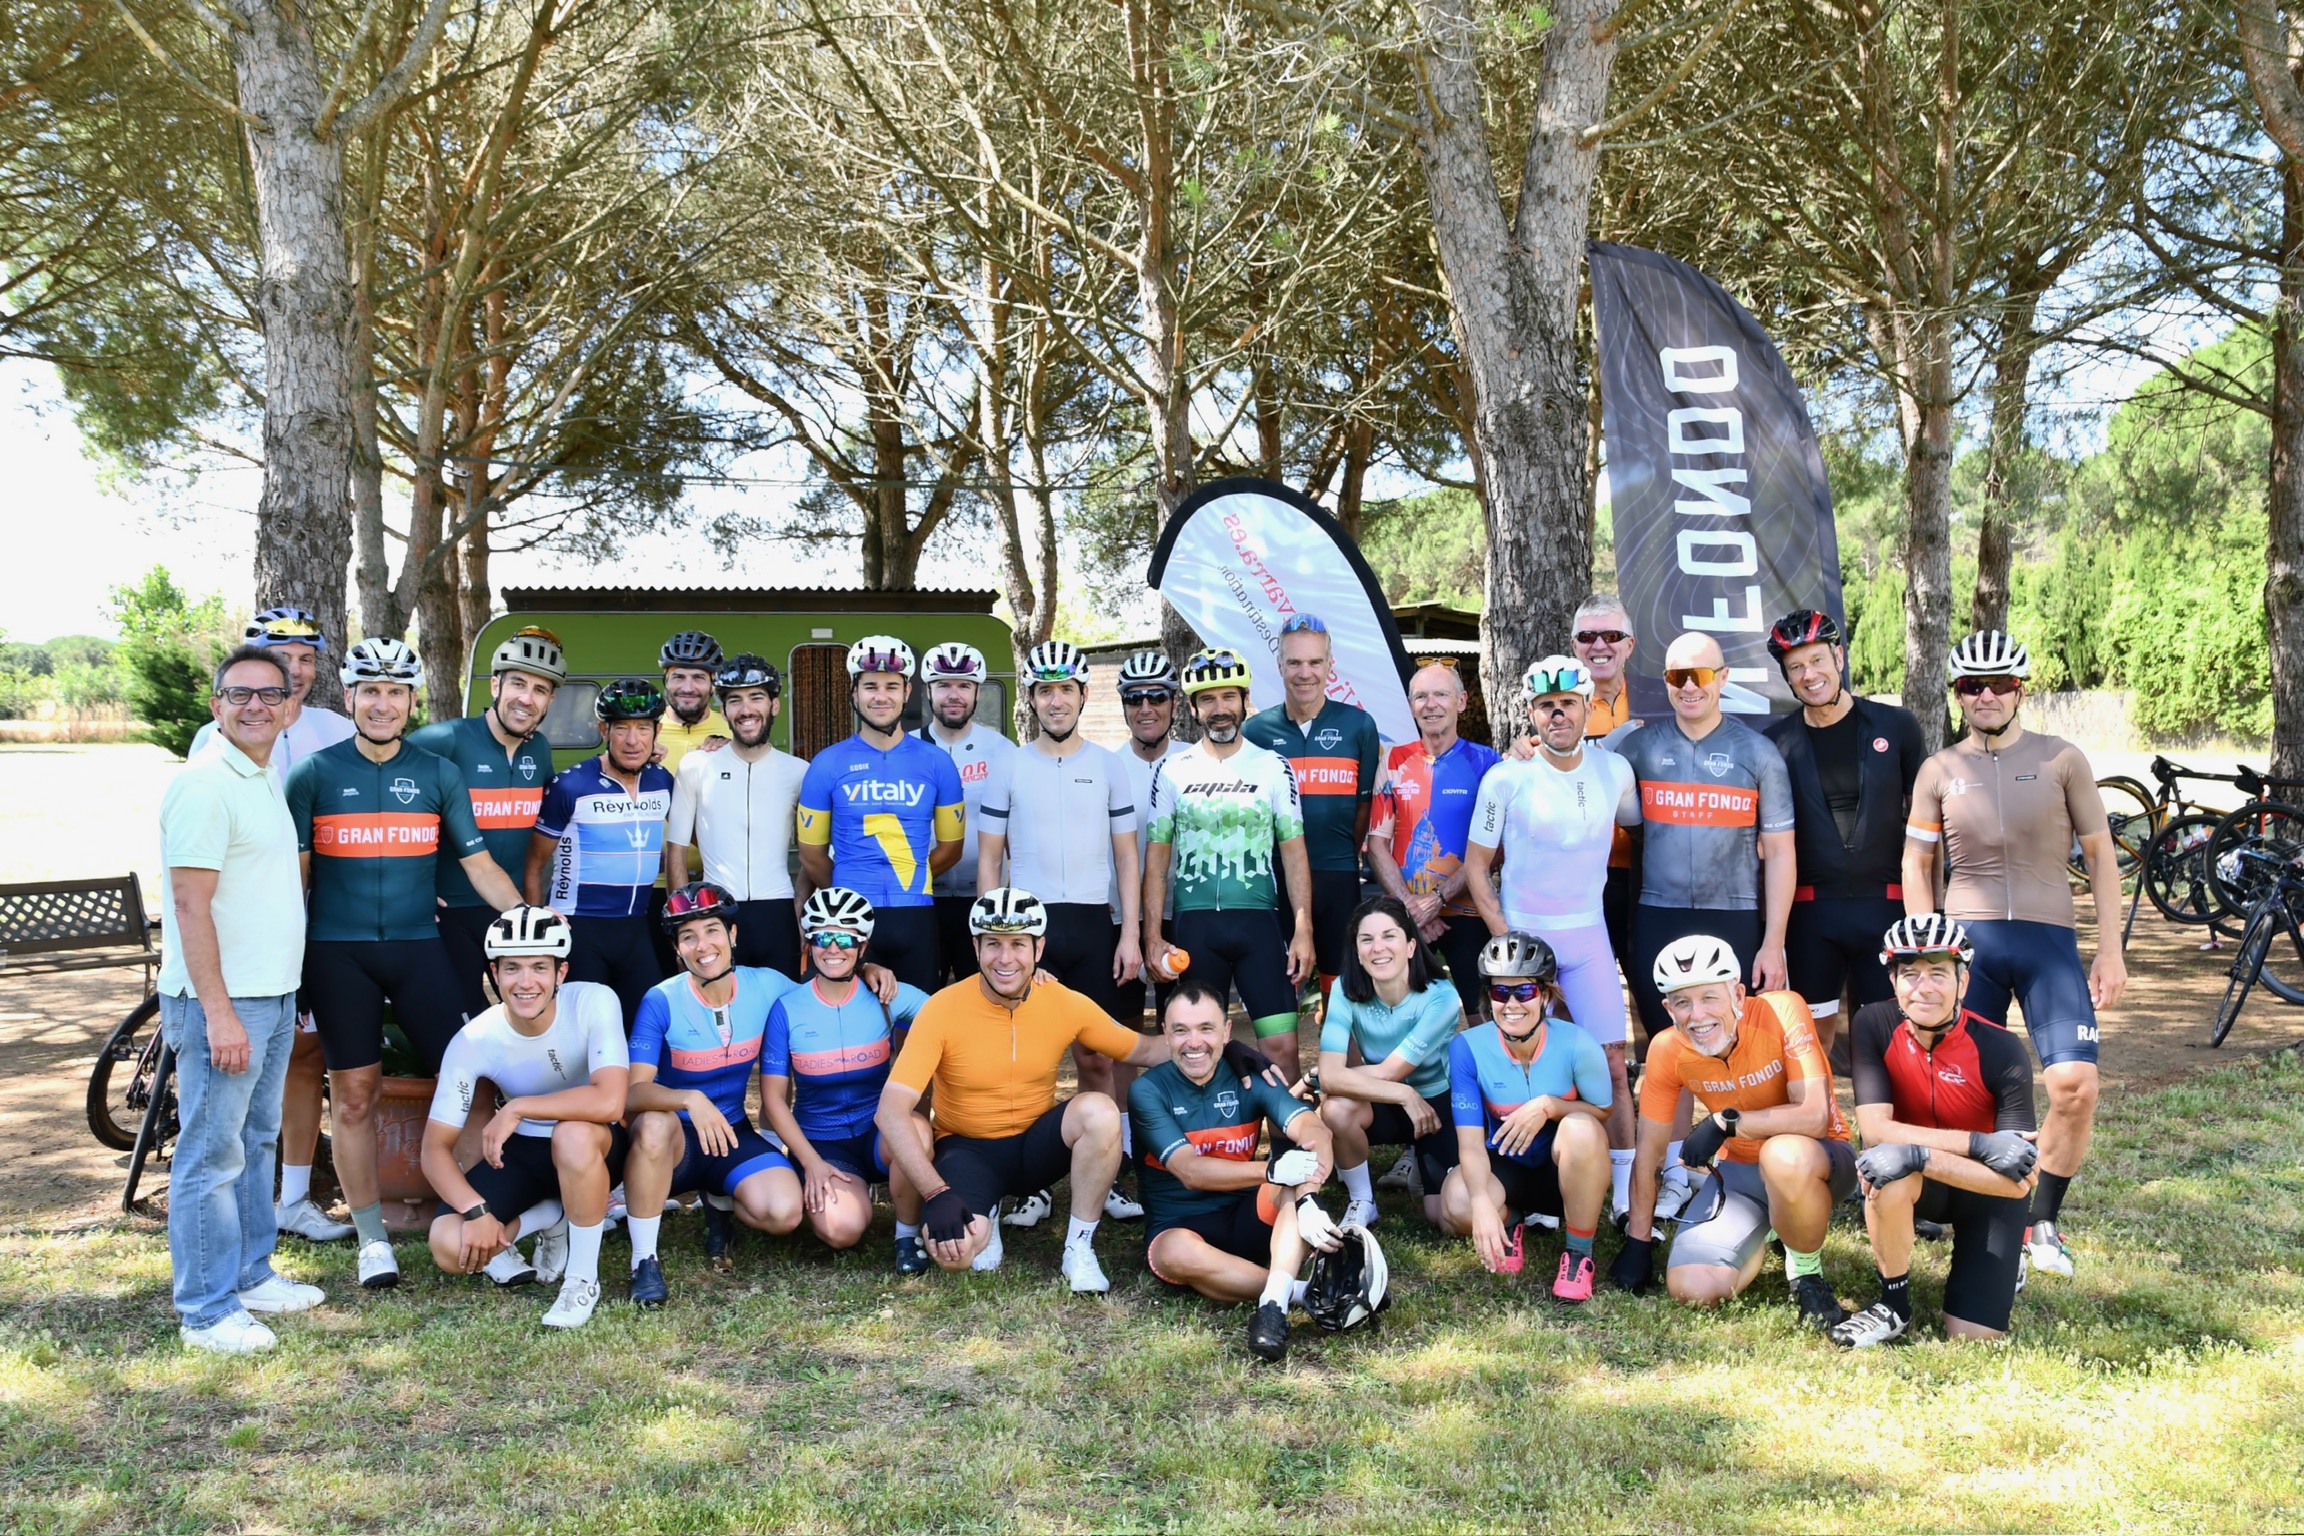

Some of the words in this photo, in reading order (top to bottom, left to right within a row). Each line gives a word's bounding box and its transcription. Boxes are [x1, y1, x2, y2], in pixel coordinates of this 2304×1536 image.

[1310, 768, 1354, 784] FONDO
[842, 779, 926, 807] vitaly
[1576, 781, 1585, 808] tactic
[1655, 789, 1695, 808] GRAN
[1698, 792, 1752, 811] FONDO
[472, 801, 512, 817] GRAN
[1483, 800, 1496, 833] tactic
[1673, 810, 1713, 819] STAFF
[338, 827, 383, 844] GRAN
[388, 826, 436, 843] FONDO
[547, 1048, 562, 1072] tactic
[682, 1055, 719, 1067] LADIES
[850, 1049, 882, 1063] ROAD
[1703, 1079, 1737, 1093] GRAN
[1738, 1059, 1783, 1089] FONDO
[457, 1080, 470, 1113] tactic
